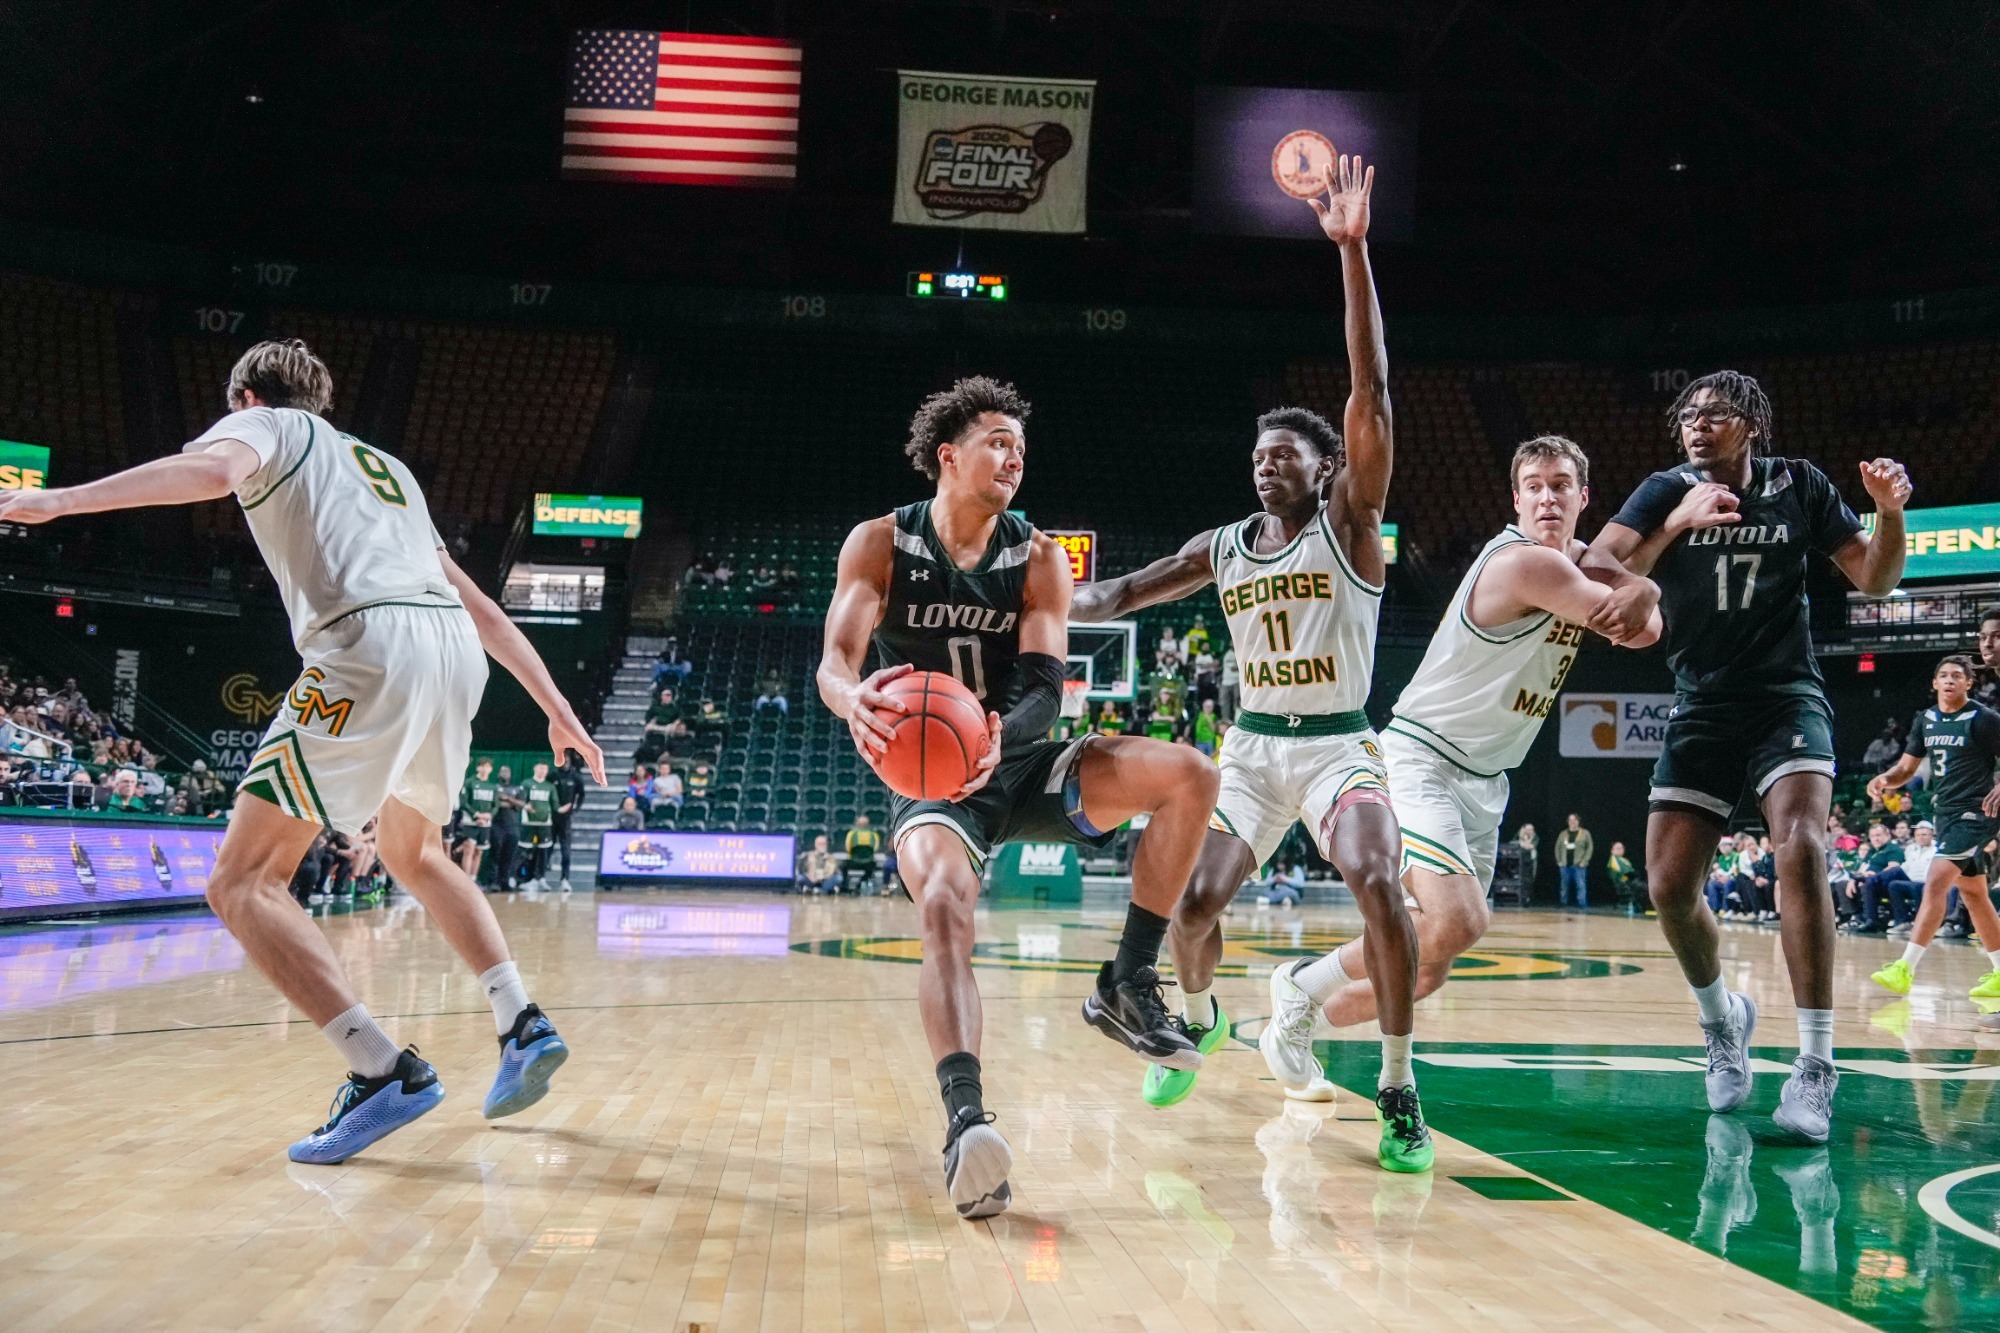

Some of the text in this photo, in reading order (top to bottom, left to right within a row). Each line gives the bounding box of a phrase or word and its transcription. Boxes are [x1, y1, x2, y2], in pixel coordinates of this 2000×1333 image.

[903, 82, 1090, 110] GEORGE MASON
[955, 144, 1034, 165] FINAL
[926, 160, 1032, 189] FOUR
[255, 262, 298, 286] 107
[509, 283, 552, 304] 107
[782, 296, 826, 317] 108
[196, 307, 245, 333] 107
[1082, 309, 1126, 330] 109
[351, 443, 407, 508] 9
[536, 507, 640, 525] DEFENSE
[1688, 524, 1789, 546] LOYOLA
[1222, 572, 1332, 617] GEORGE
[1714, 554, 1762, 611] 17
[907, 603, 1017, 634] LOYOLA
[1262, 609, 1293, 653] 11
[947, 634, 988, 701] 0
[1244, 655, 1337, 688] MASON
[289, 666, 356, 738] GM
[1924, 735, 1966, 747] LOYOLA
[1932, 749, 1946, 777] 3
[683, 850, 776, 861] JUDGEMENT
[718, 838, 746, 849] THE
[1020, 843, 1067, 866] NW
